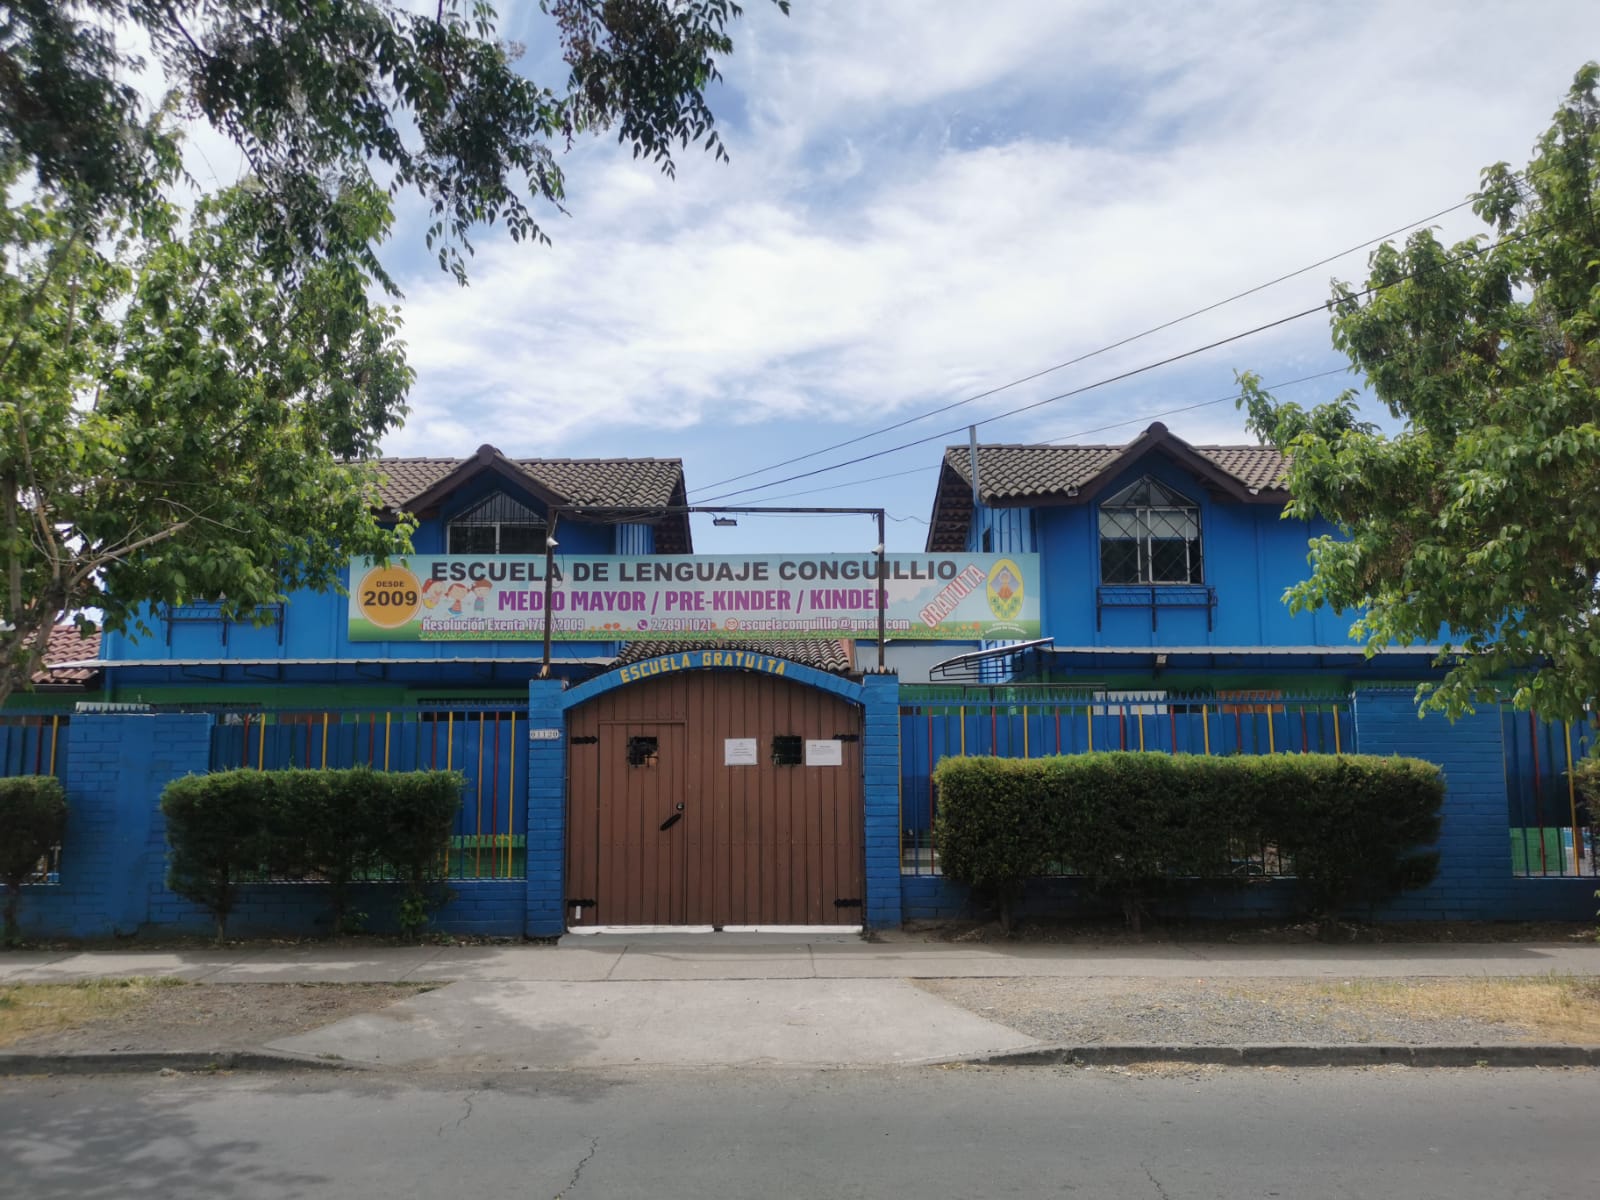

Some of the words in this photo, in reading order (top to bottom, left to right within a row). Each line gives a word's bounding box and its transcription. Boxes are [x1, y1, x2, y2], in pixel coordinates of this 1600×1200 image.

[431, 562, 563, 582] ESCUELA
[573, 562, 609, 582] DE
[619, 561, 769, 582] LENGUAJE
[778, 560, 957, 580] CONGUILLIO
[376, 580, 405, 588] DESDE
[363, 590, 418, 606] 2009
[498, 591, 565, 611] MEDO
[571, 591, 646, 611] MAYOR
[665, 590, 791, 611] PRE-KINDER
[919, 564, 987, 629] GRATUITA
[422, 617, 485, 631] Resolución
[487, 618, 525, 631] Exenta
[619, 653, 691, 683] ESCUELA
